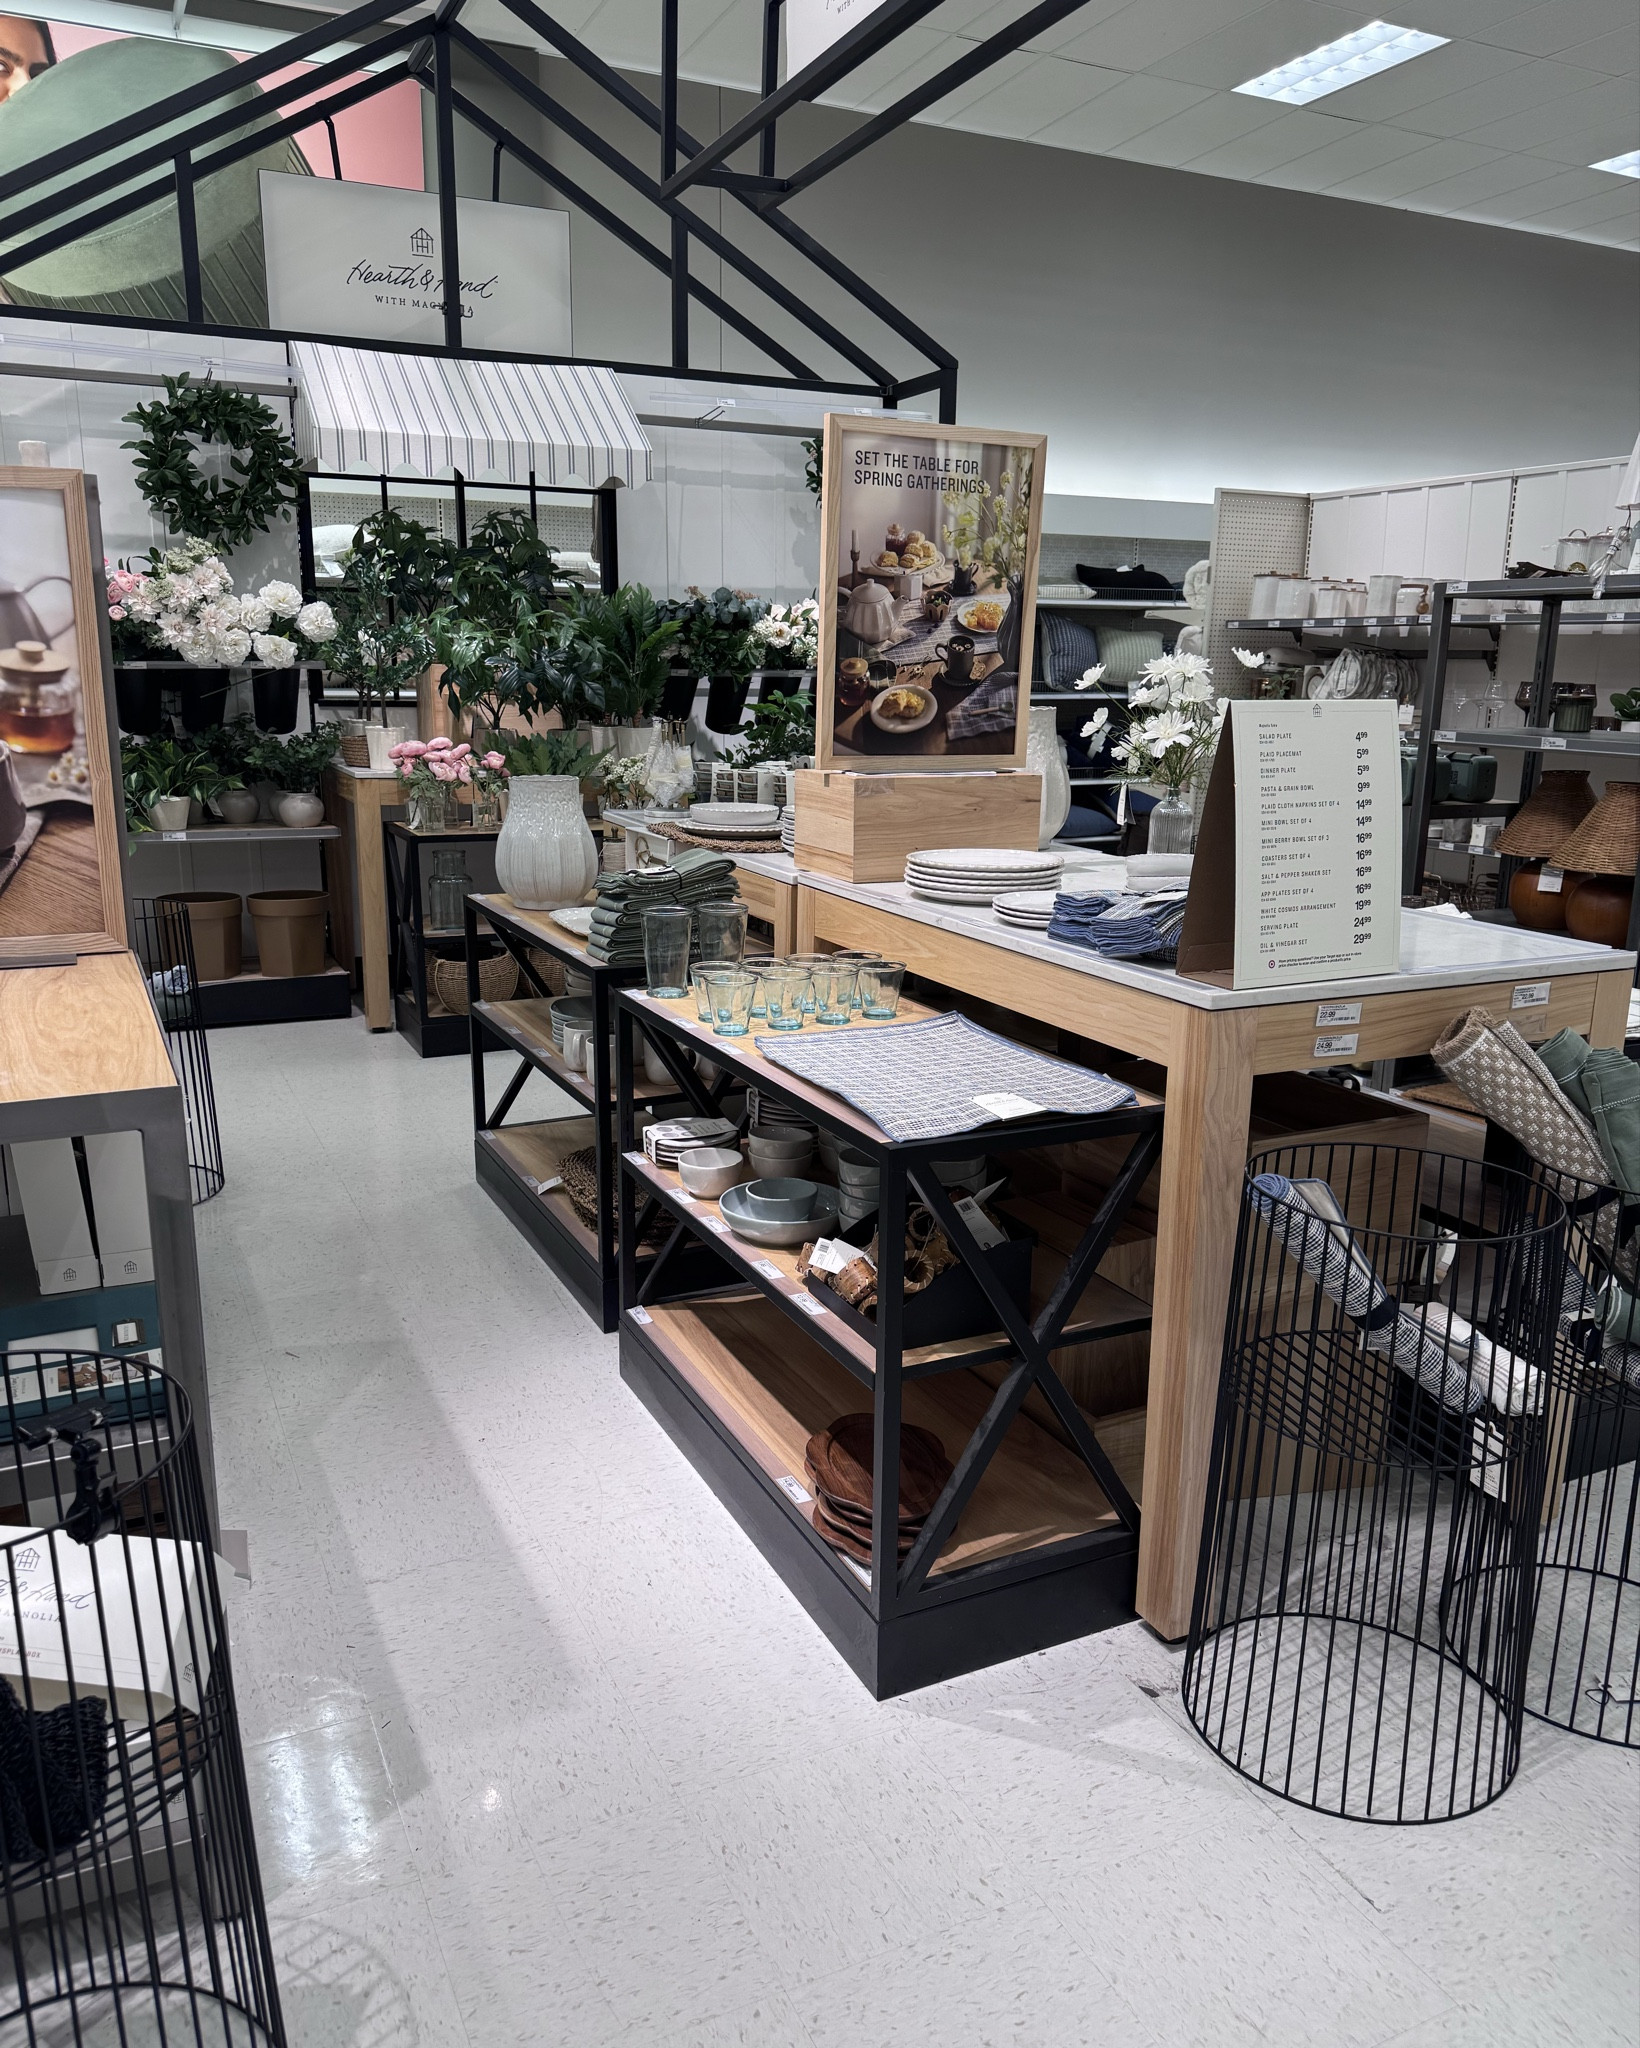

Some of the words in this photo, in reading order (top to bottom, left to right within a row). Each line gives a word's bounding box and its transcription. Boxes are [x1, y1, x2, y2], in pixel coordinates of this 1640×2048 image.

[346, 259, 423, 289] Hearth
[420, 269, 435, 292] &
[375, 295, 406, 306] WITH
[412, 299, 474, 313] MAGA
[855, 450, 880, 466] SET
[884, 453, 909, 469] THE
[913, 455, 951, 472] TABLE
[955, 459, 979, 475] FOR
[854, 470, 902, 488] SPRING
[907, 474, 985, 494] GATHERINGS
[1261, 854, 1287, 862] COASTERS
[1300, 903, 1336, 911] ARRANGEMENT
